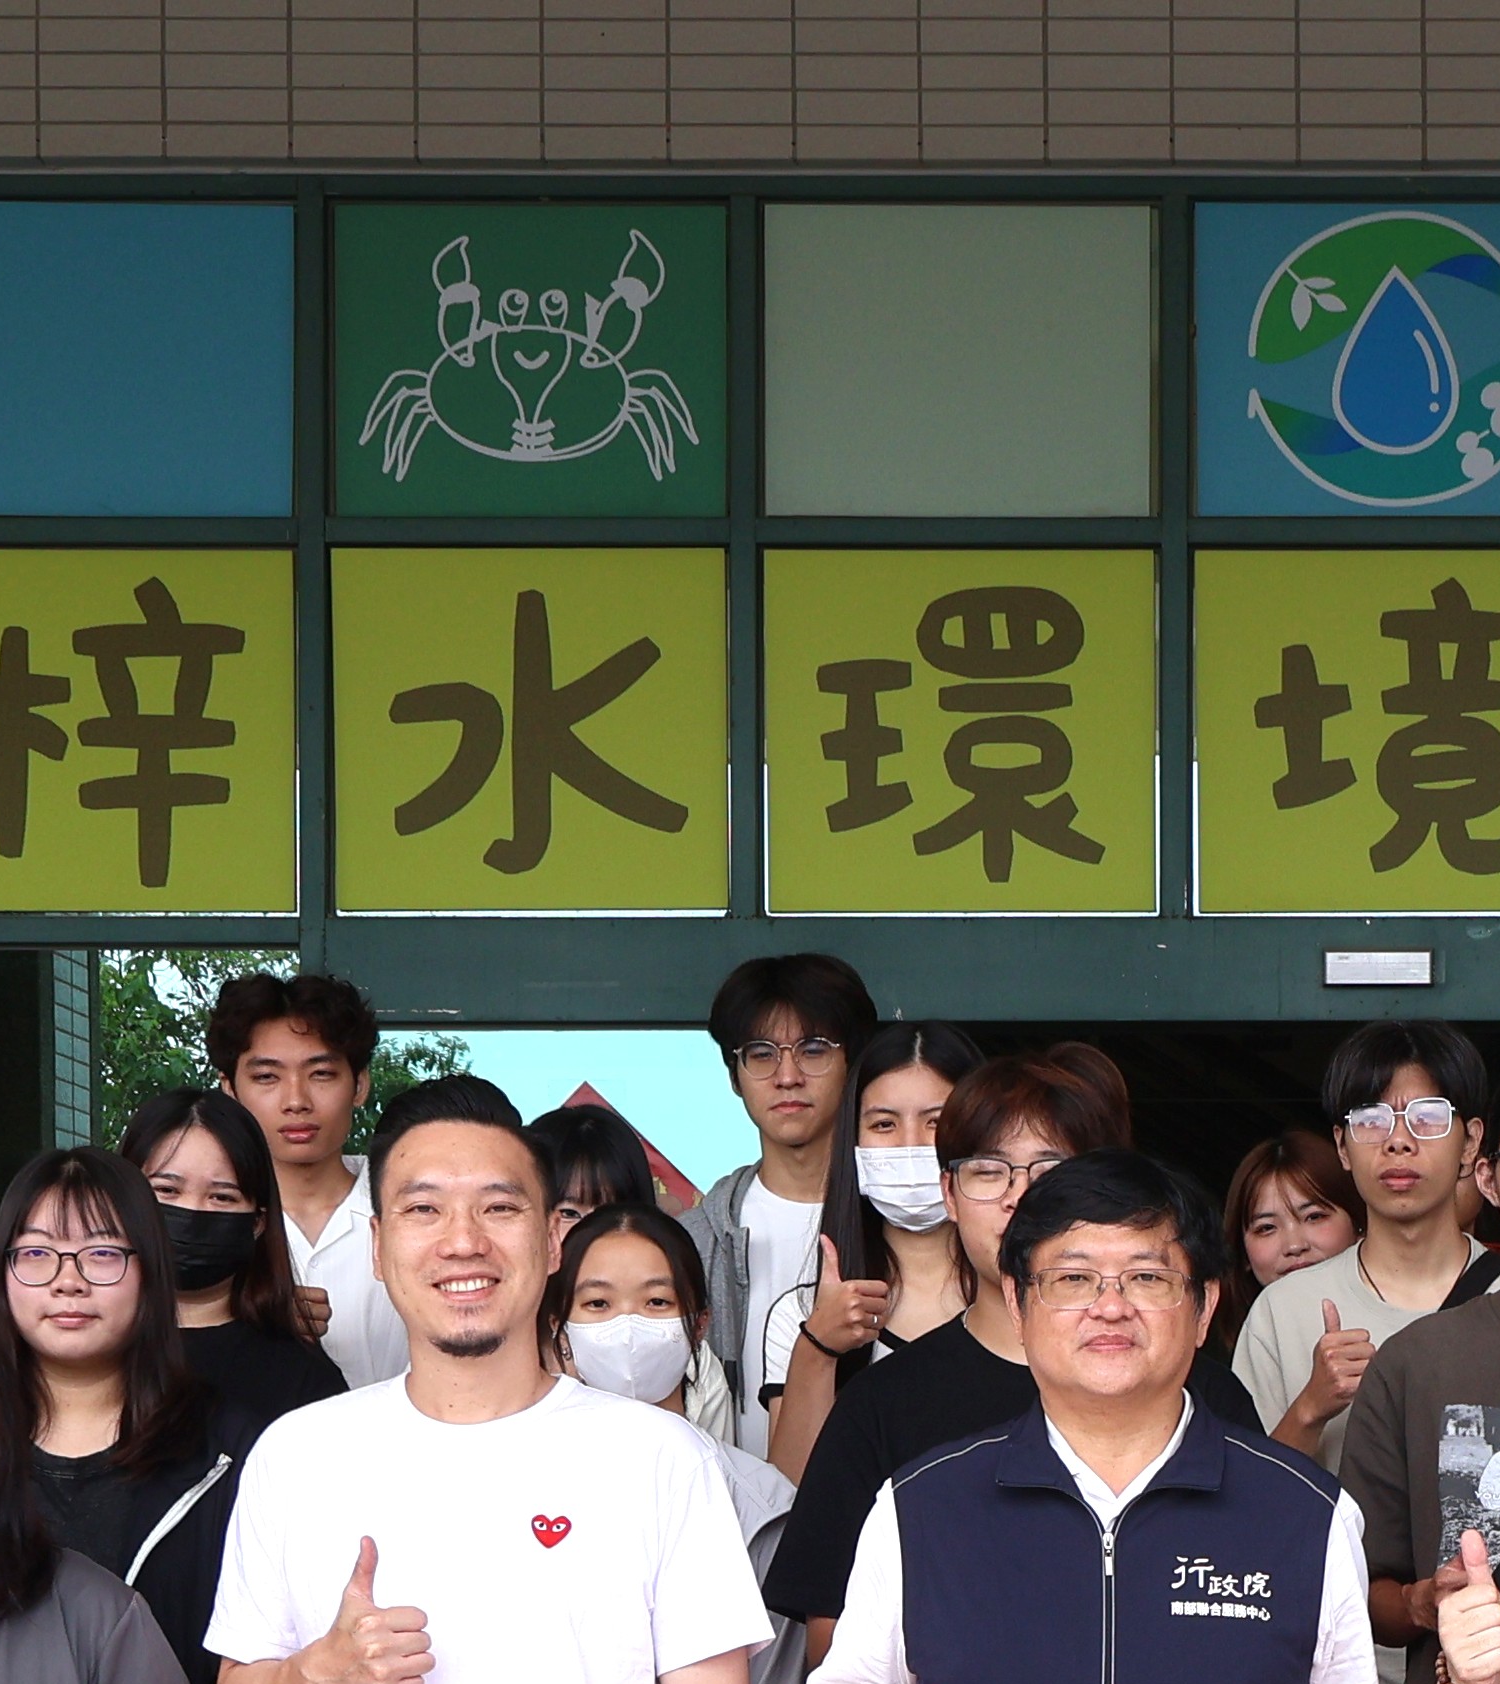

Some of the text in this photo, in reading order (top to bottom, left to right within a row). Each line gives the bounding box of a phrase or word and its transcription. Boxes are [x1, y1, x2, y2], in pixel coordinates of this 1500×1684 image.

[1171, 1555, 1272, 1598] 行政院
[1170, 1600, 1271, 1621] 南部聯合服務中心
